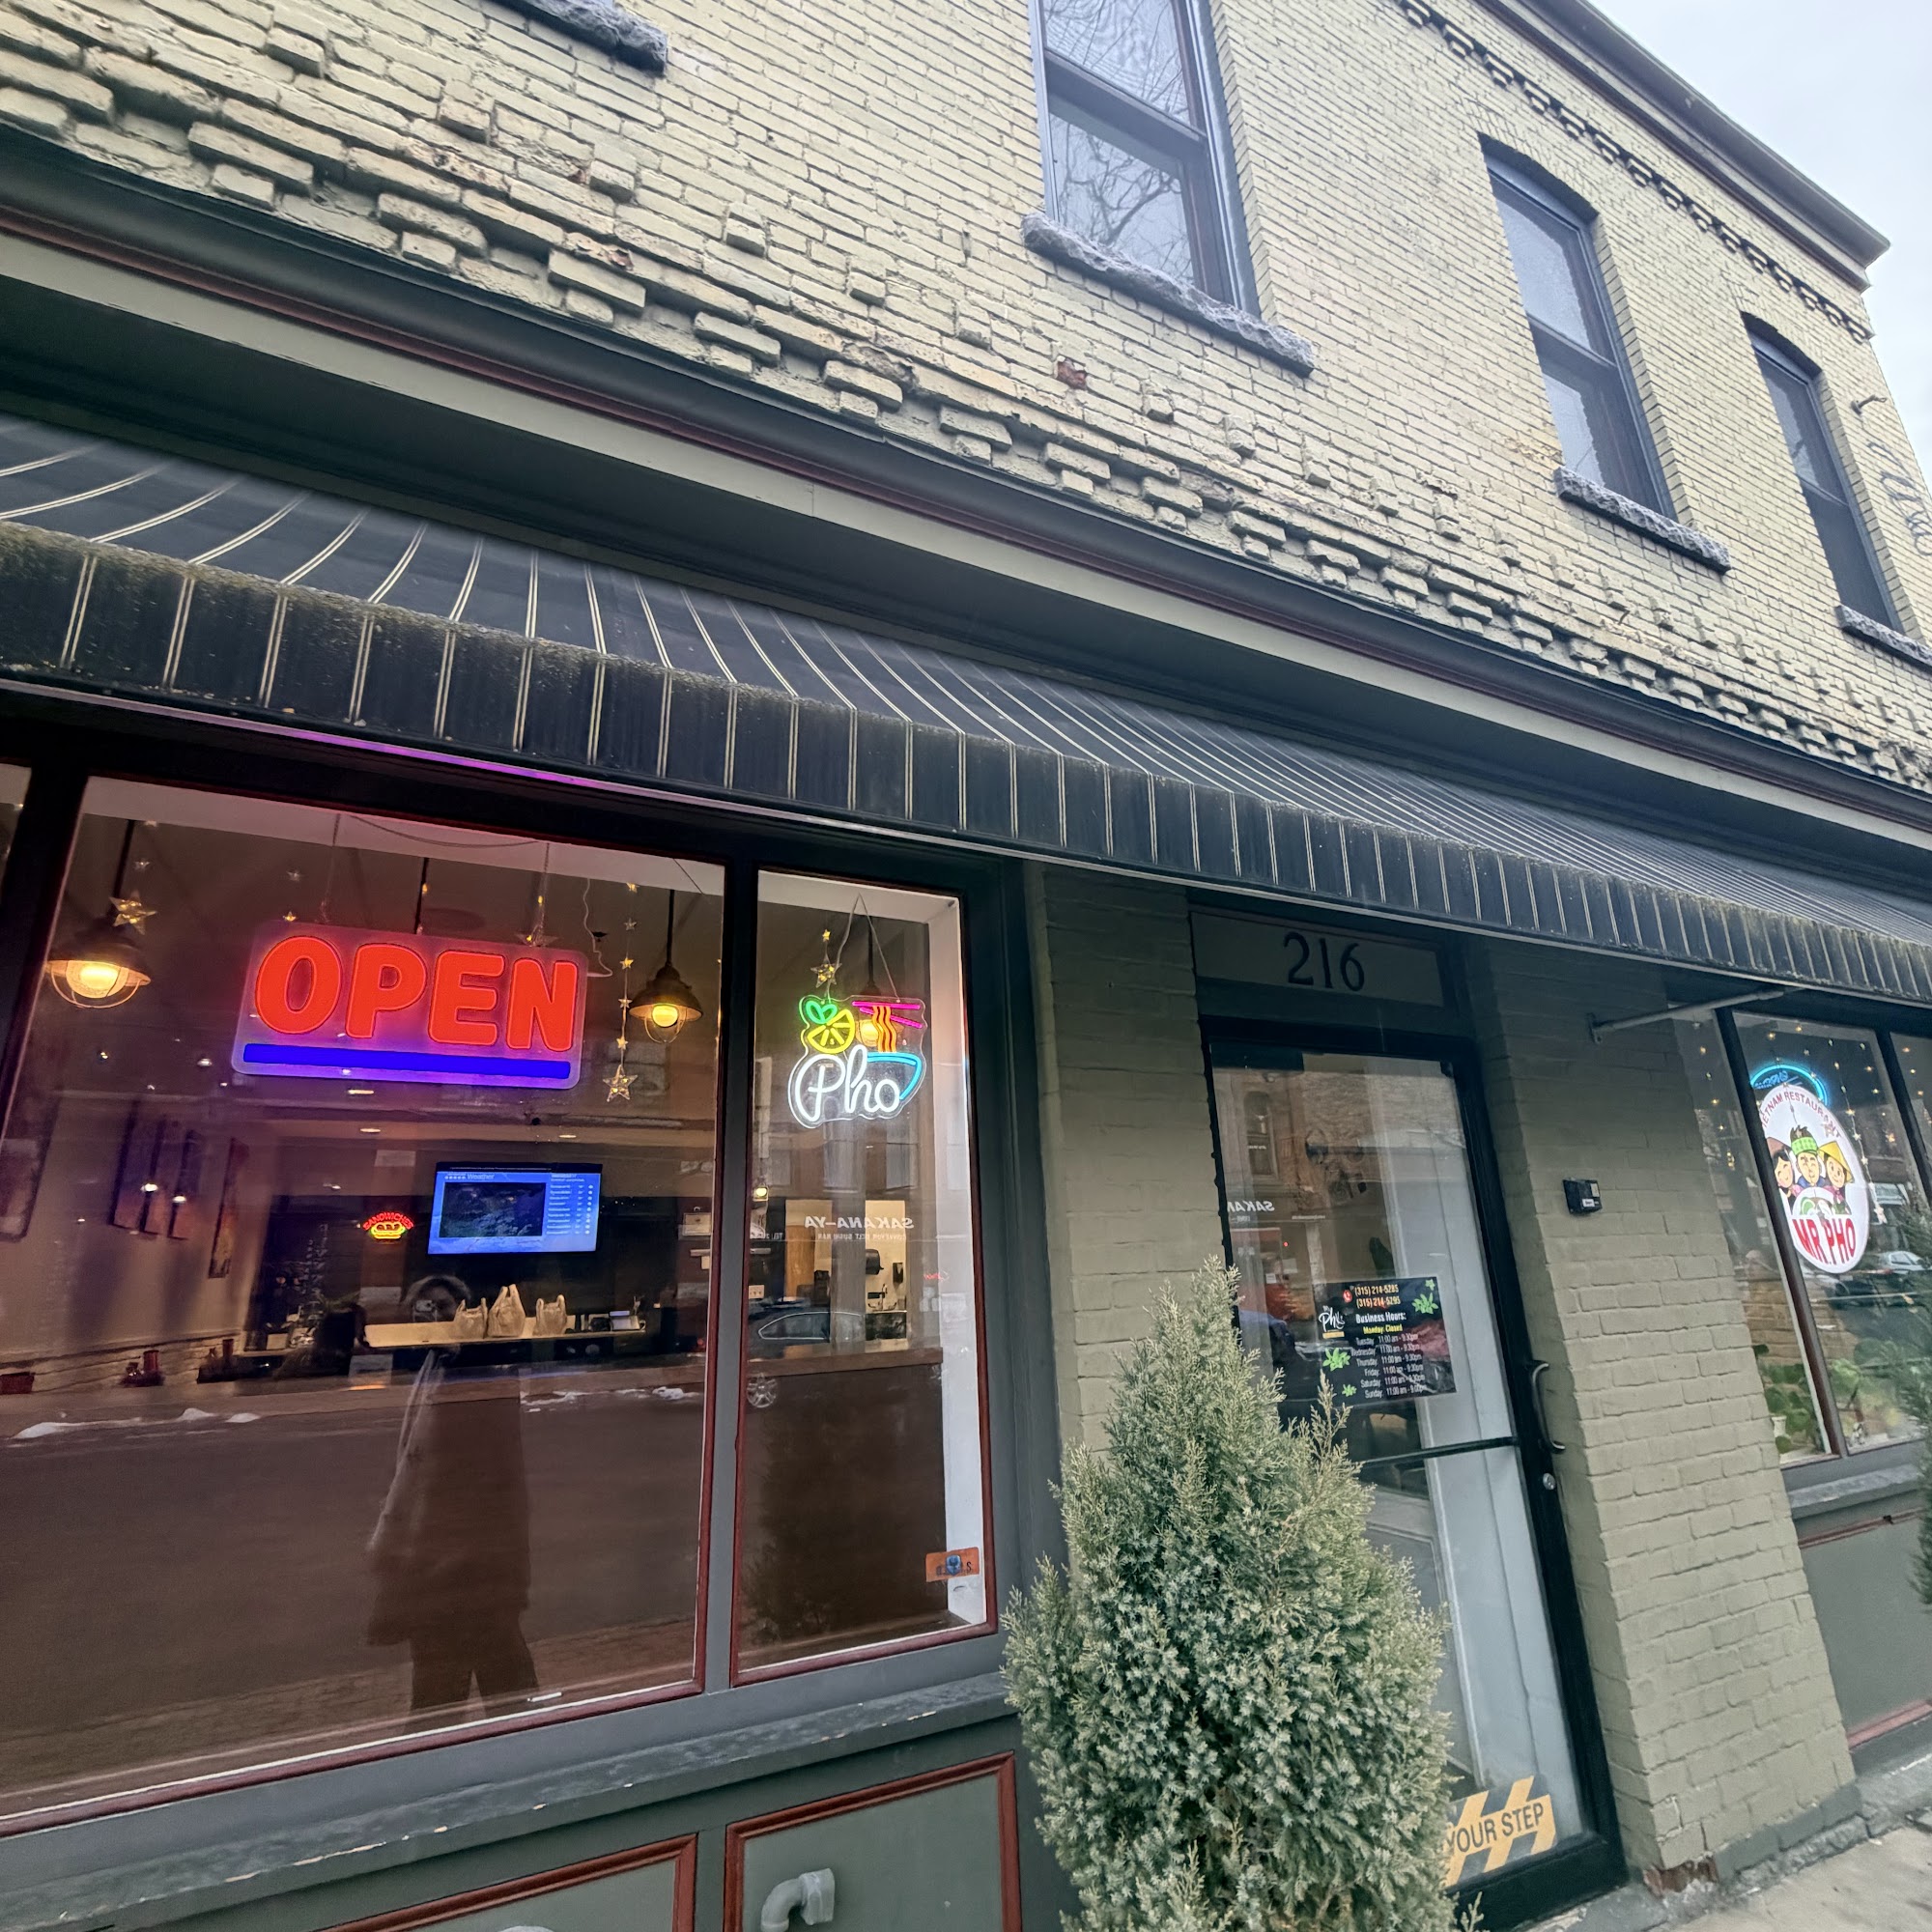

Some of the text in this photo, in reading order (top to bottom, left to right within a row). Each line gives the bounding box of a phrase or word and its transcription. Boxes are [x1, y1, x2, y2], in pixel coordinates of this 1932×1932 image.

[1283, 932, 1365, 991] 216
[255, 935, 578, 1052] OPEN
[795, 1044, 900, 1122] Pho
[363, 1212, 413, 1230] SANDWICHES
[1355, 1286, 1371, 1296] (315)
[1356, 1297, 1373, 1309] (315)
[1355, 1312, 1406, 1323] Business Hours:
[1446, 1803, 1544, 1853] YOUR STEP
